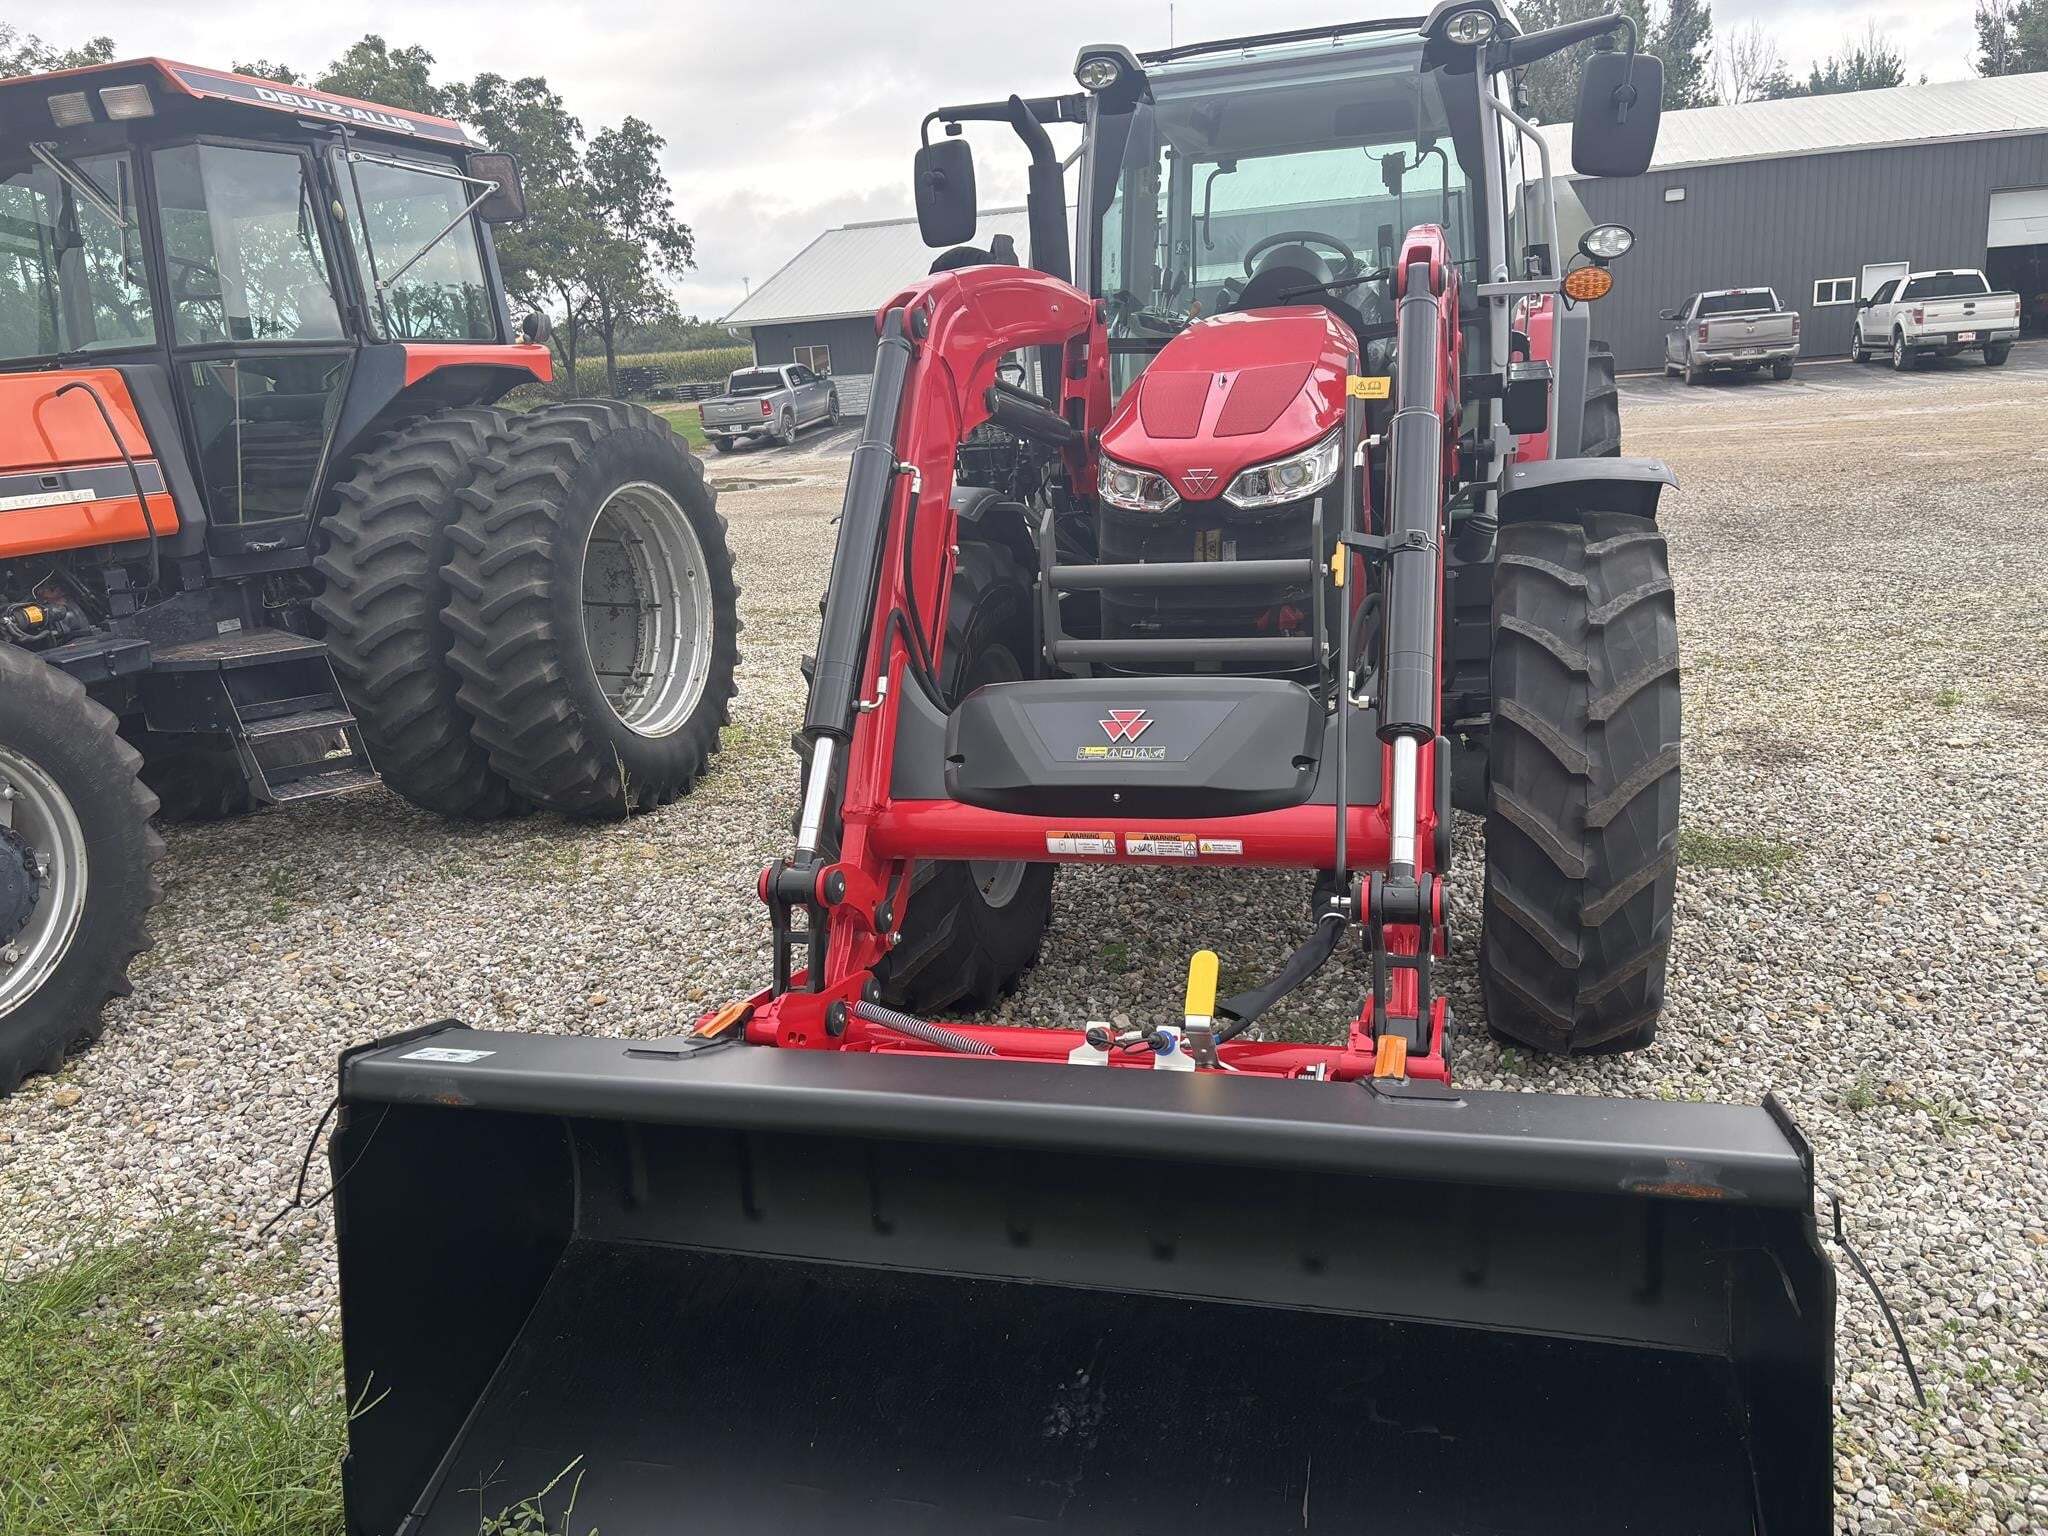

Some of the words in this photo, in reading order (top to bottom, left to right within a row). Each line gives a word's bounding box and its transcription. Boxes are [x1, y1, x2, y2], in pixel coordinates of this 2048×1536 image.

[254, 87, 416, 131] DEUTZ-ALLIS
[1069, 832, 1100, 840] WARNING
[1149, 834, 1181, 842] WARNING
